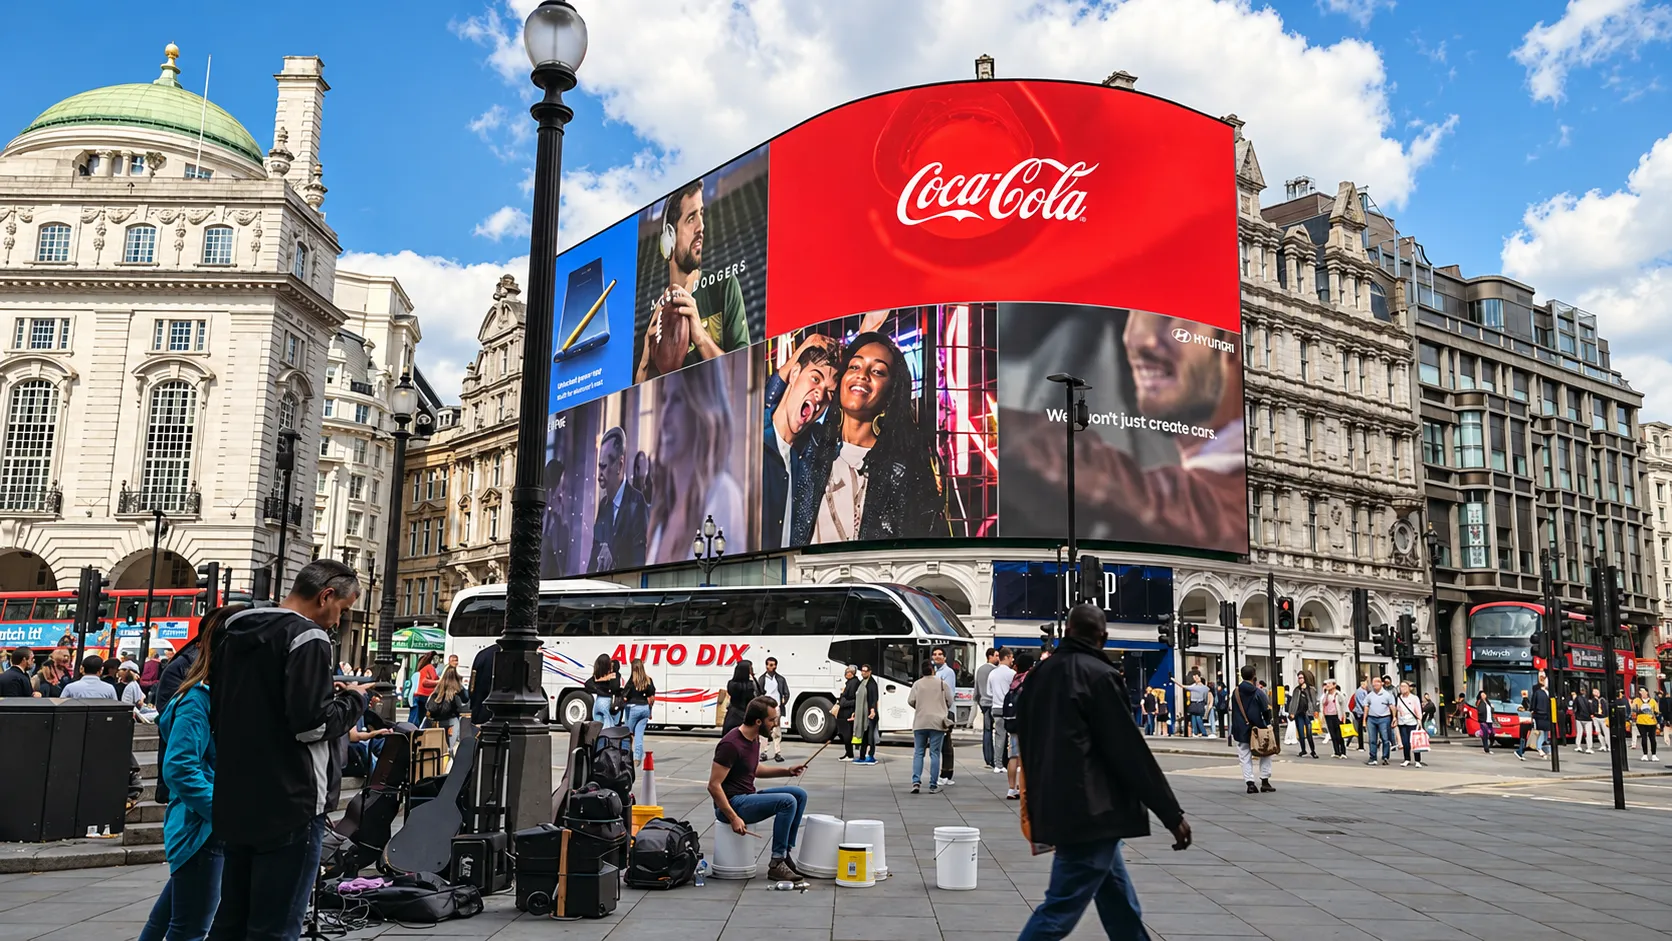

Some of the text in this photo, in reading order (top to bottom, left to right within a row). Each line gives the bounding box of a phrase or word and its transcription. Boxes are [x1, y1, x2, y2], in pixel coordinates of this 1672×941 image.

[896, 157, 1100, 226] Coca-Cola
[1193, 333, 1235, 353] HYUNDAI
[1046, 408, 1068, 423] We
[1120, 412, 1146, 429] just
[1148, 418, 1189, 434] create
[1191, 425, 1218, 440] cars.
[1065, 570, 1116, 611] GP
[610, 644, 750, 667] AUTO DIX
